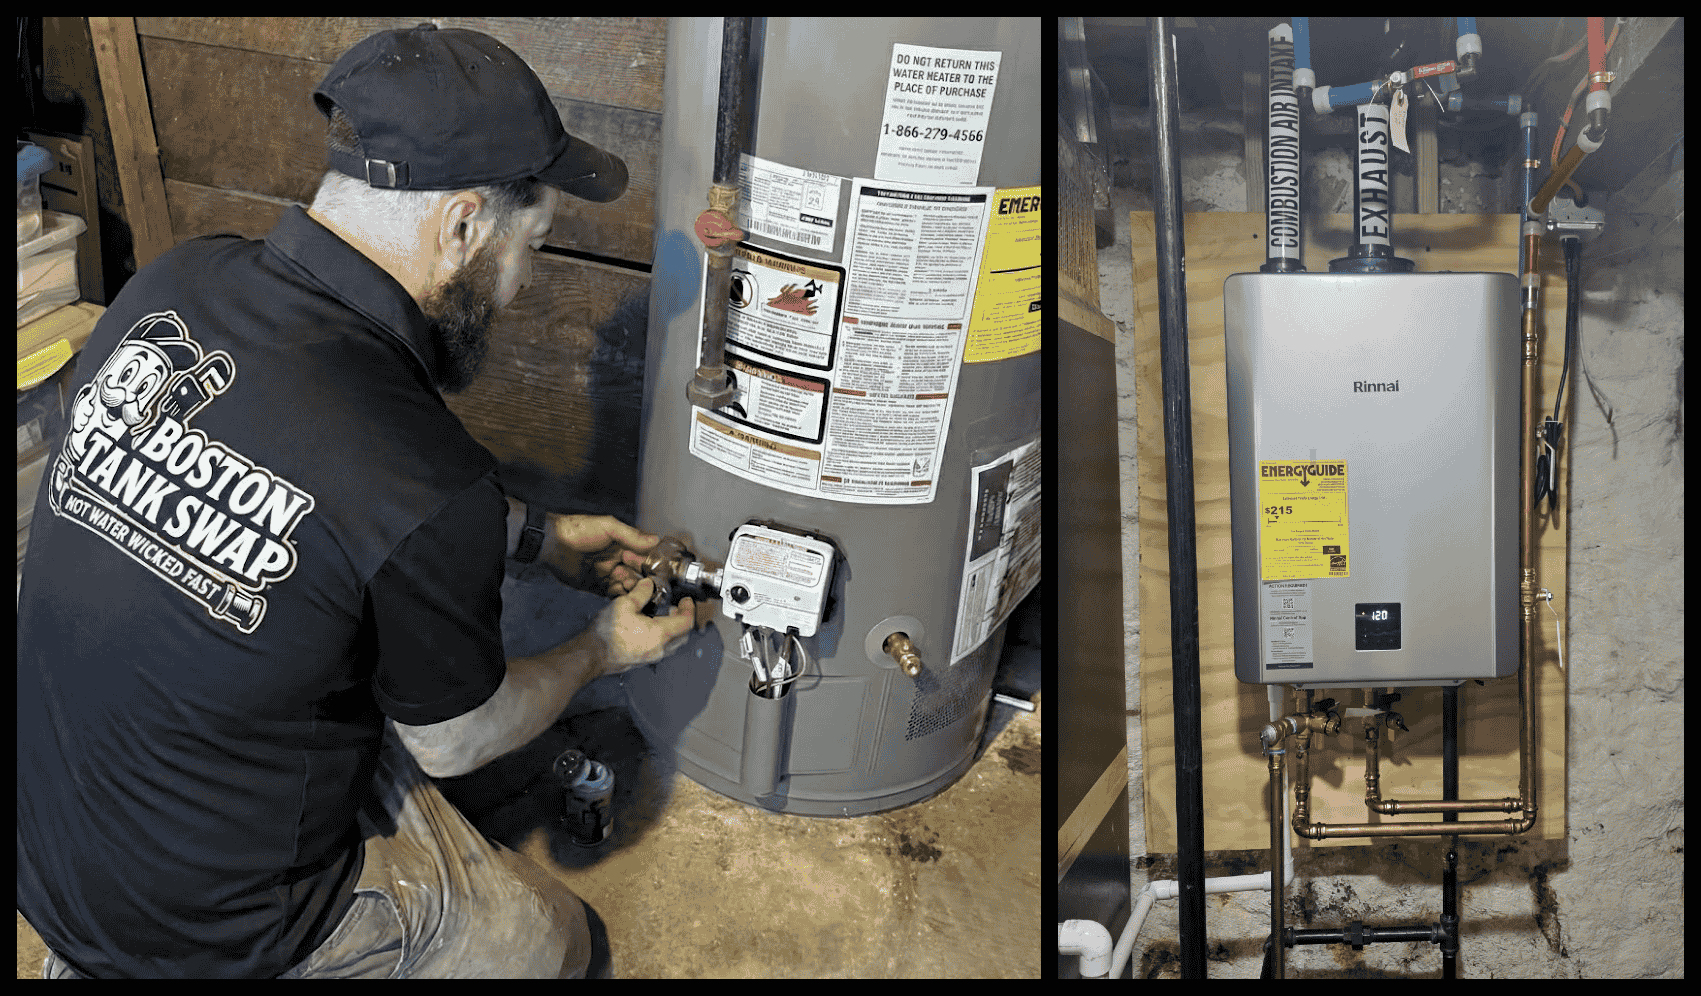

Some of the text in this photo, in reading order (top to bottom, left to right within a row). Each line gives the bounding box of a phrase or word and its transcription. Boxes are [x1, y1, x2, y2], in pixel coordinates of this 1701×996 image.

[896, 54, 911, 65] DO
[934, 58, 972, 70] RETURN
[975, 61, 995, 71] THIS
[893, 67, 994, 85] WATER HEATER TO THE
[894, 82, 988, 98] PLACE OF PURCHASE
[1270, 101, 1299, 133] AIR
[883, 123, 984, 142] 1-866-279-4566
[1359, 112, 1389, 239] EXHAUST
[1270, 135, 1299, 248] COMBUSTION
[998, 195, 1041, 215] EMER
[1353, 380, 1400, 393] Rinnai
[138, 415, 307, 537] BOSTON
[77, 430, 290, 582] TANK SWAP
[1264, 505, 1293, 515] $215
[88, 505, 131, 543] WATER
[127, 530, 185, 578] WICKED
[180, 568, 223, 600] FAST
[1371, 610, 1388, 621] 120
